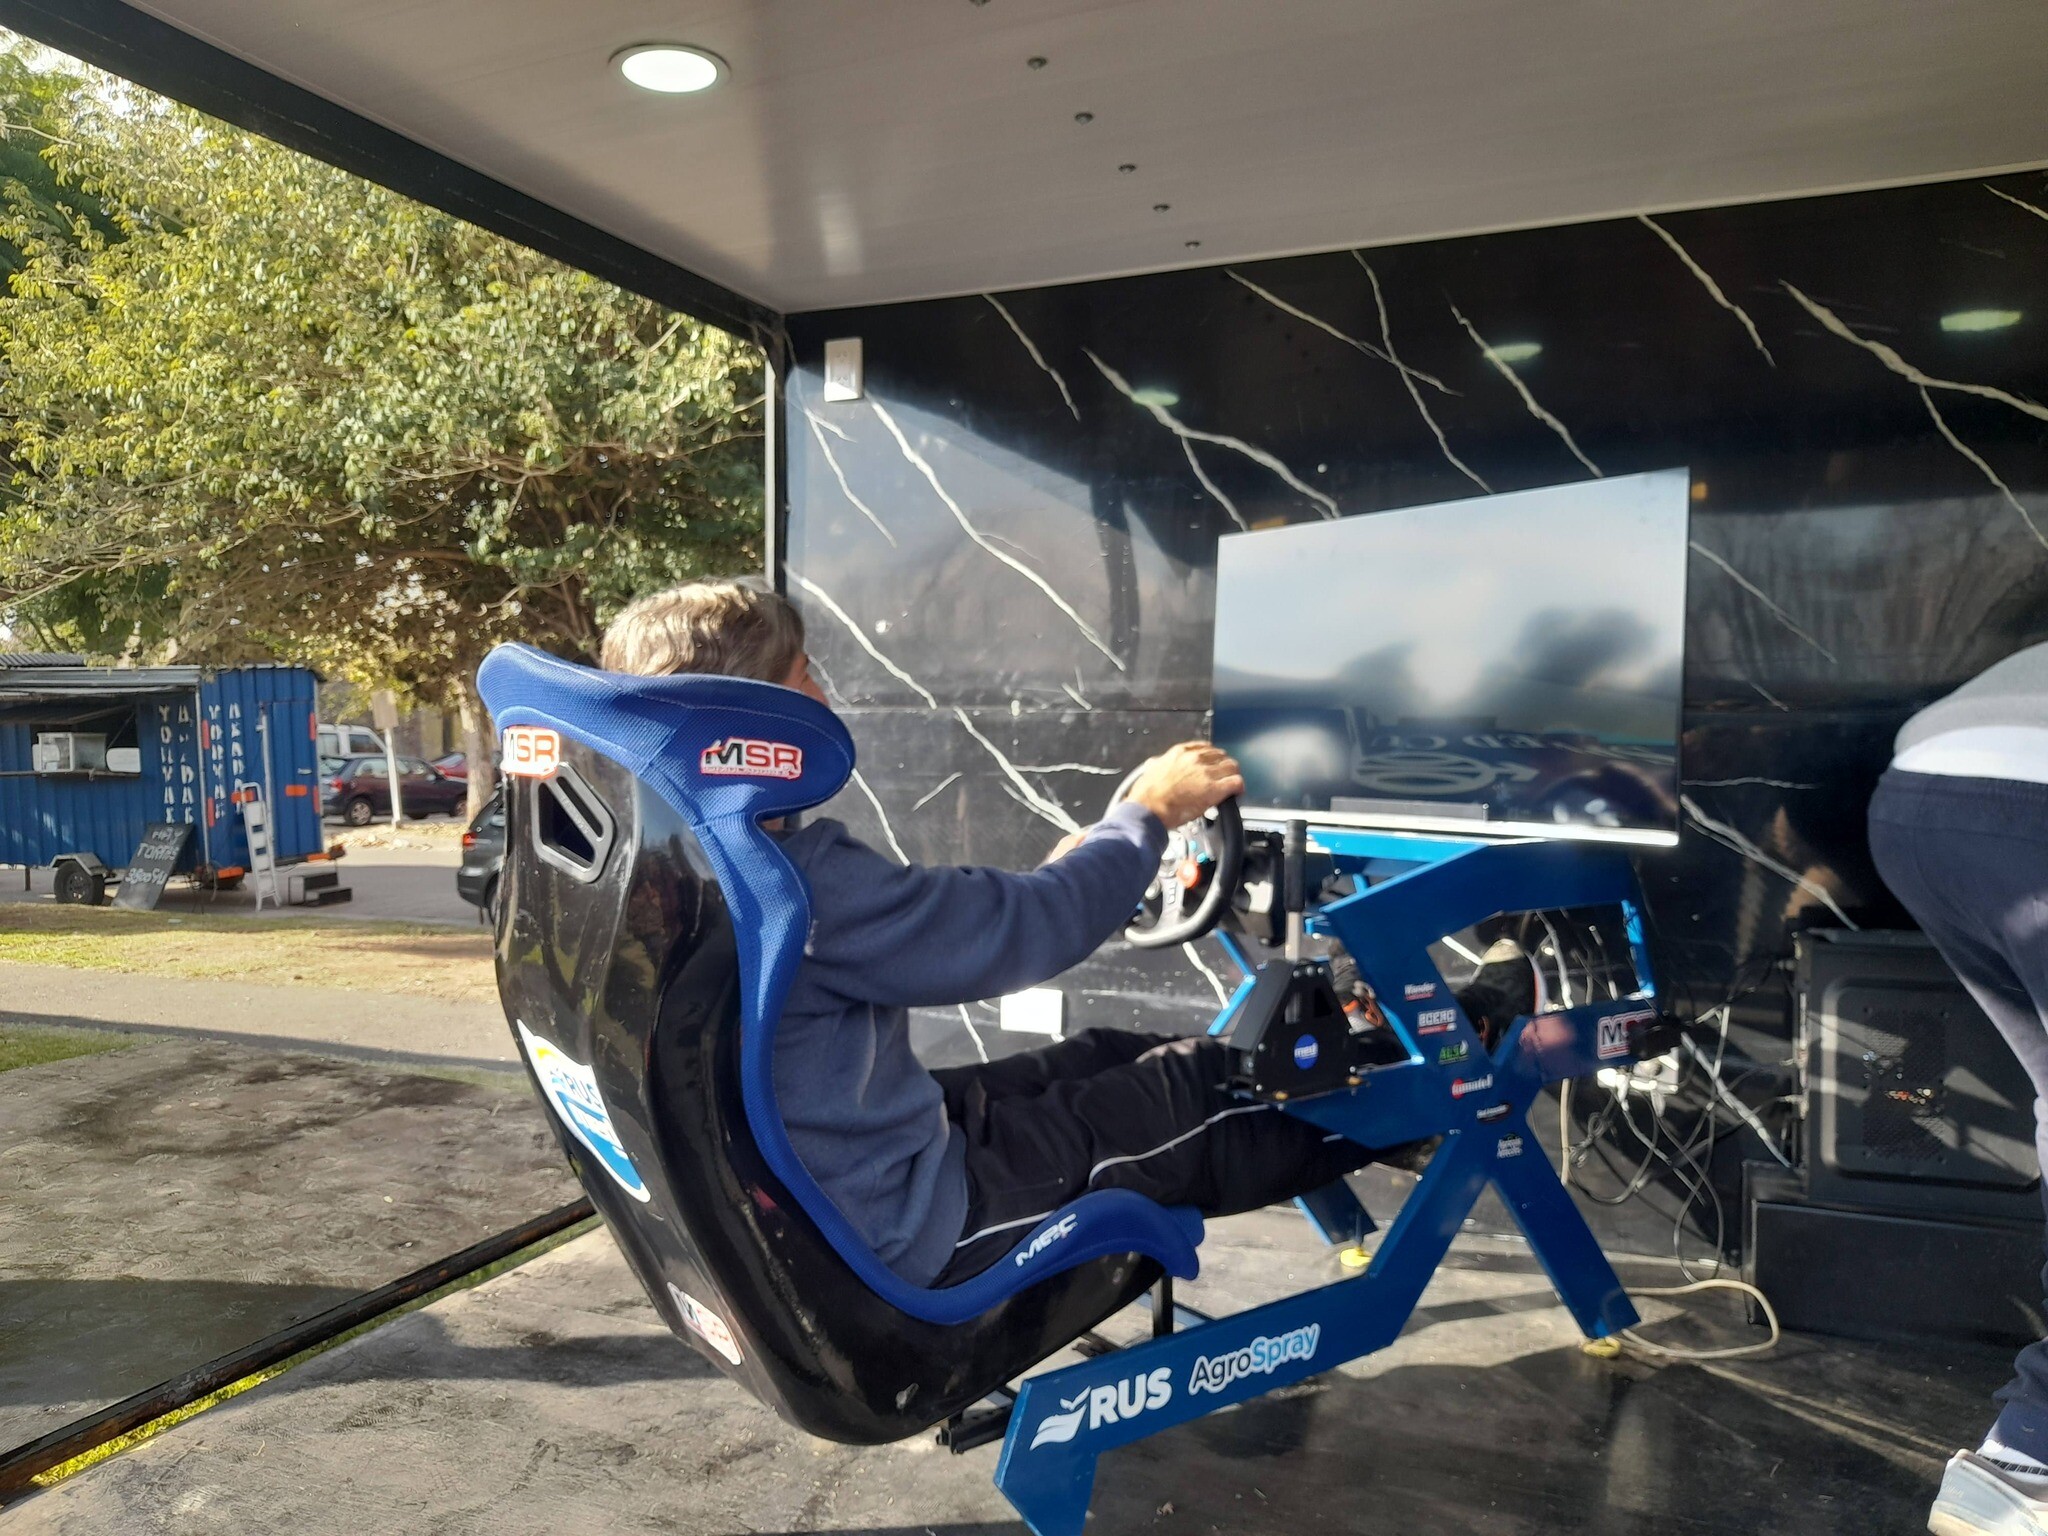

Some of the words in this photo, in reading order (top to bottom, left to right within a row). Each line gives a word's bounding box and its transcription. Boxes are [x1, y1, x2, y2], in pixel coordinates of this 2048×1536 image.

[705, 741, 799, 771] MSR
[1089, 1366, 1173, 1431] RUS
[1188, 1323, 1321, 1395] AgroSpray
